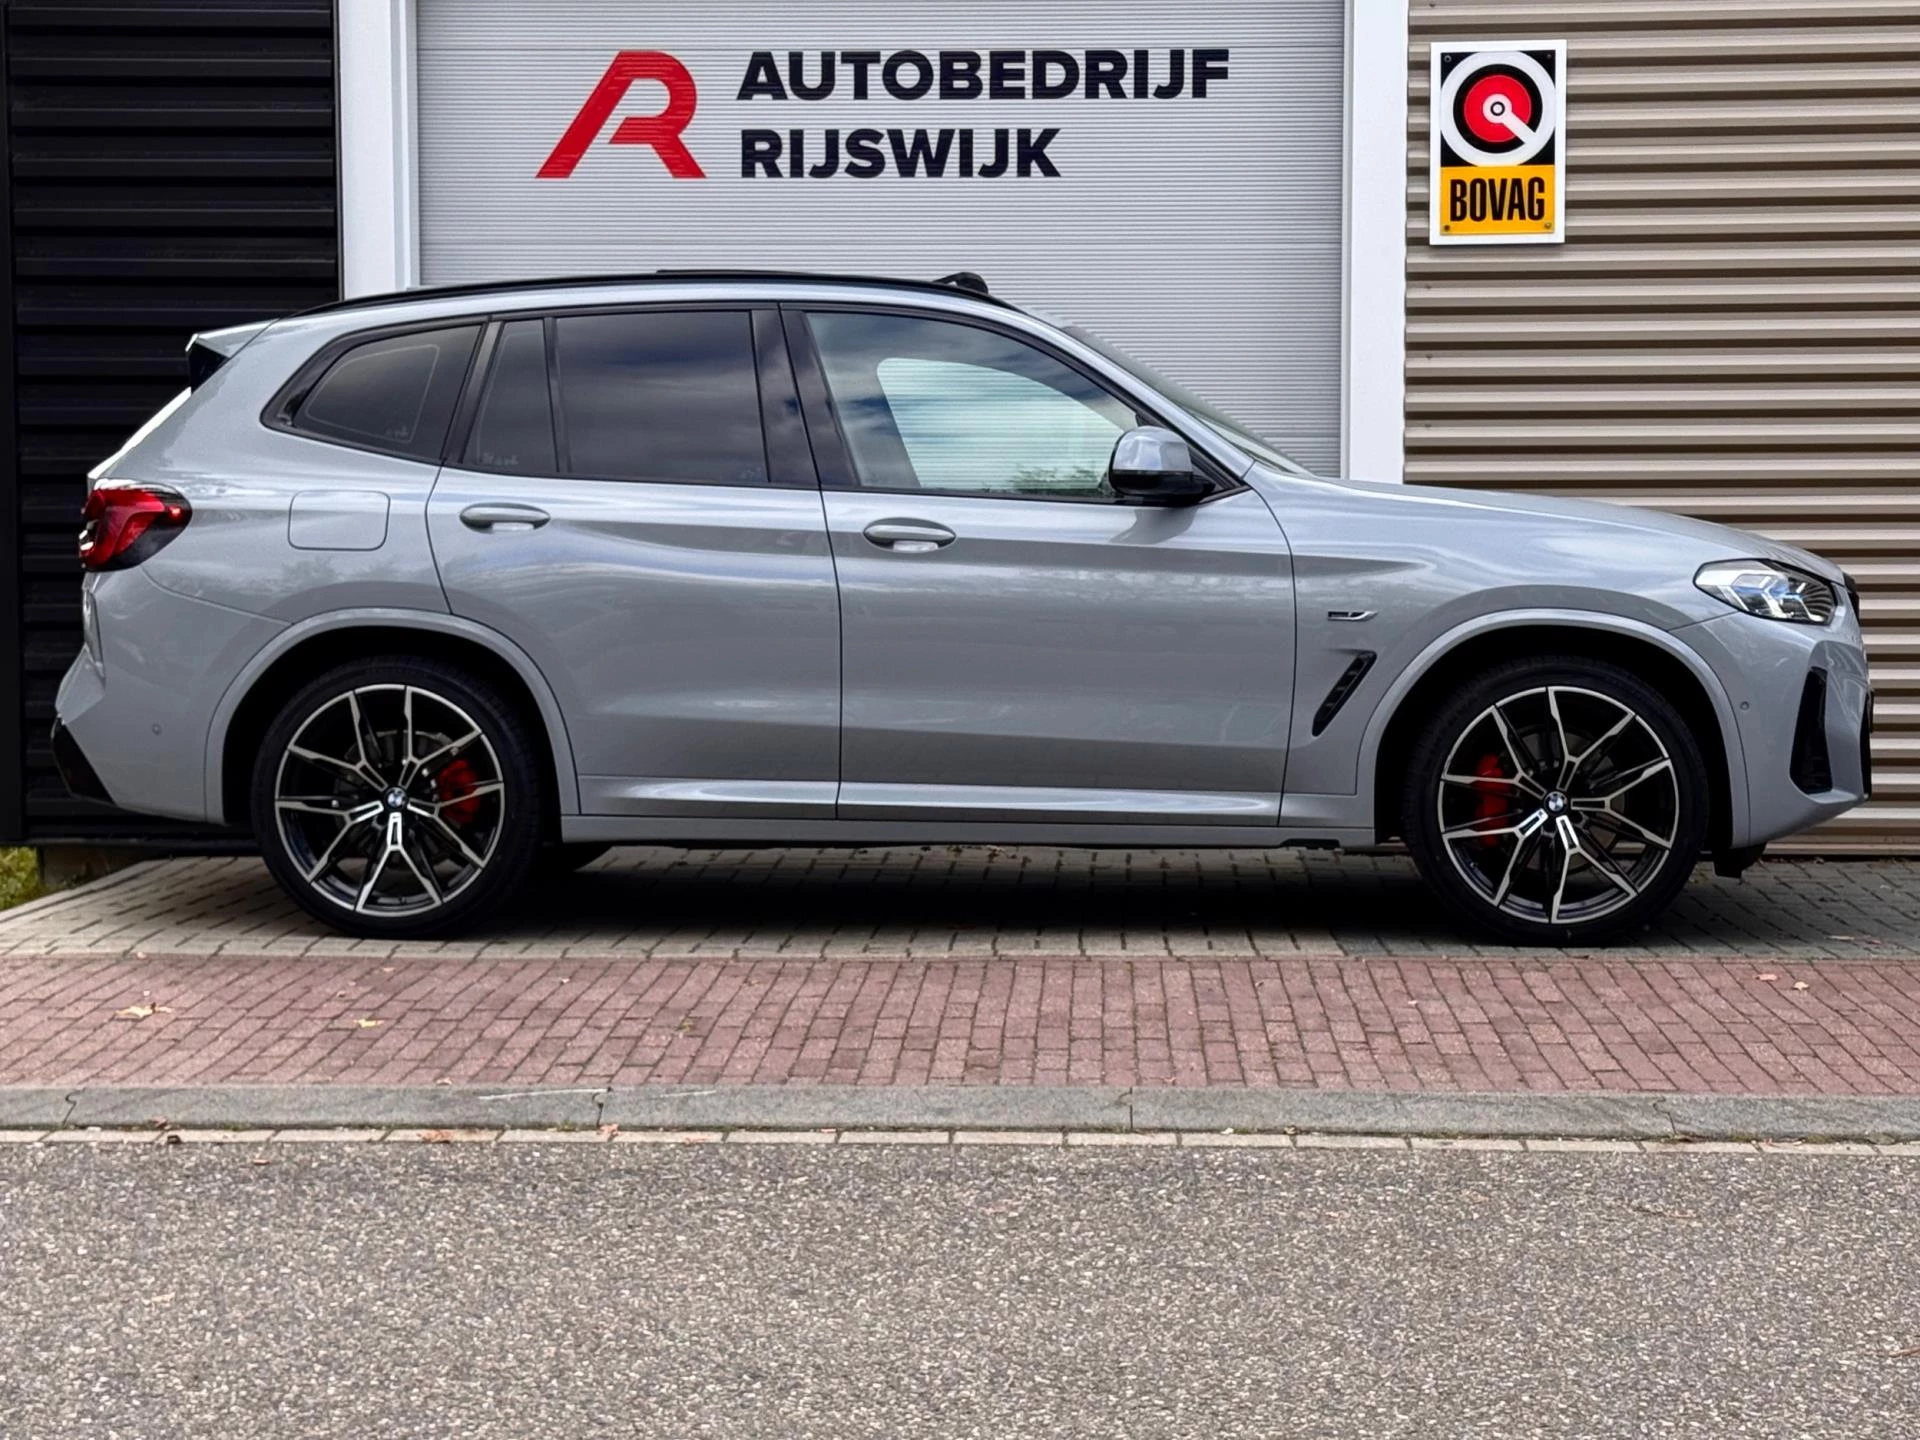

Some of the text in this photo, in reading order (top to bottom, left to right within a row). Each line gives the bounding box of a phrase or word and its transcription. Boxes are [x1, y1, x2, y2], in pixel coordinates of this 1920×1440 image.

[737, 48, 1229, 101] AUTOBEDRIJF
[741, 128, 1062, 178] RIJSWIJK
[1450, 177, 1545, 222] BOVAG
